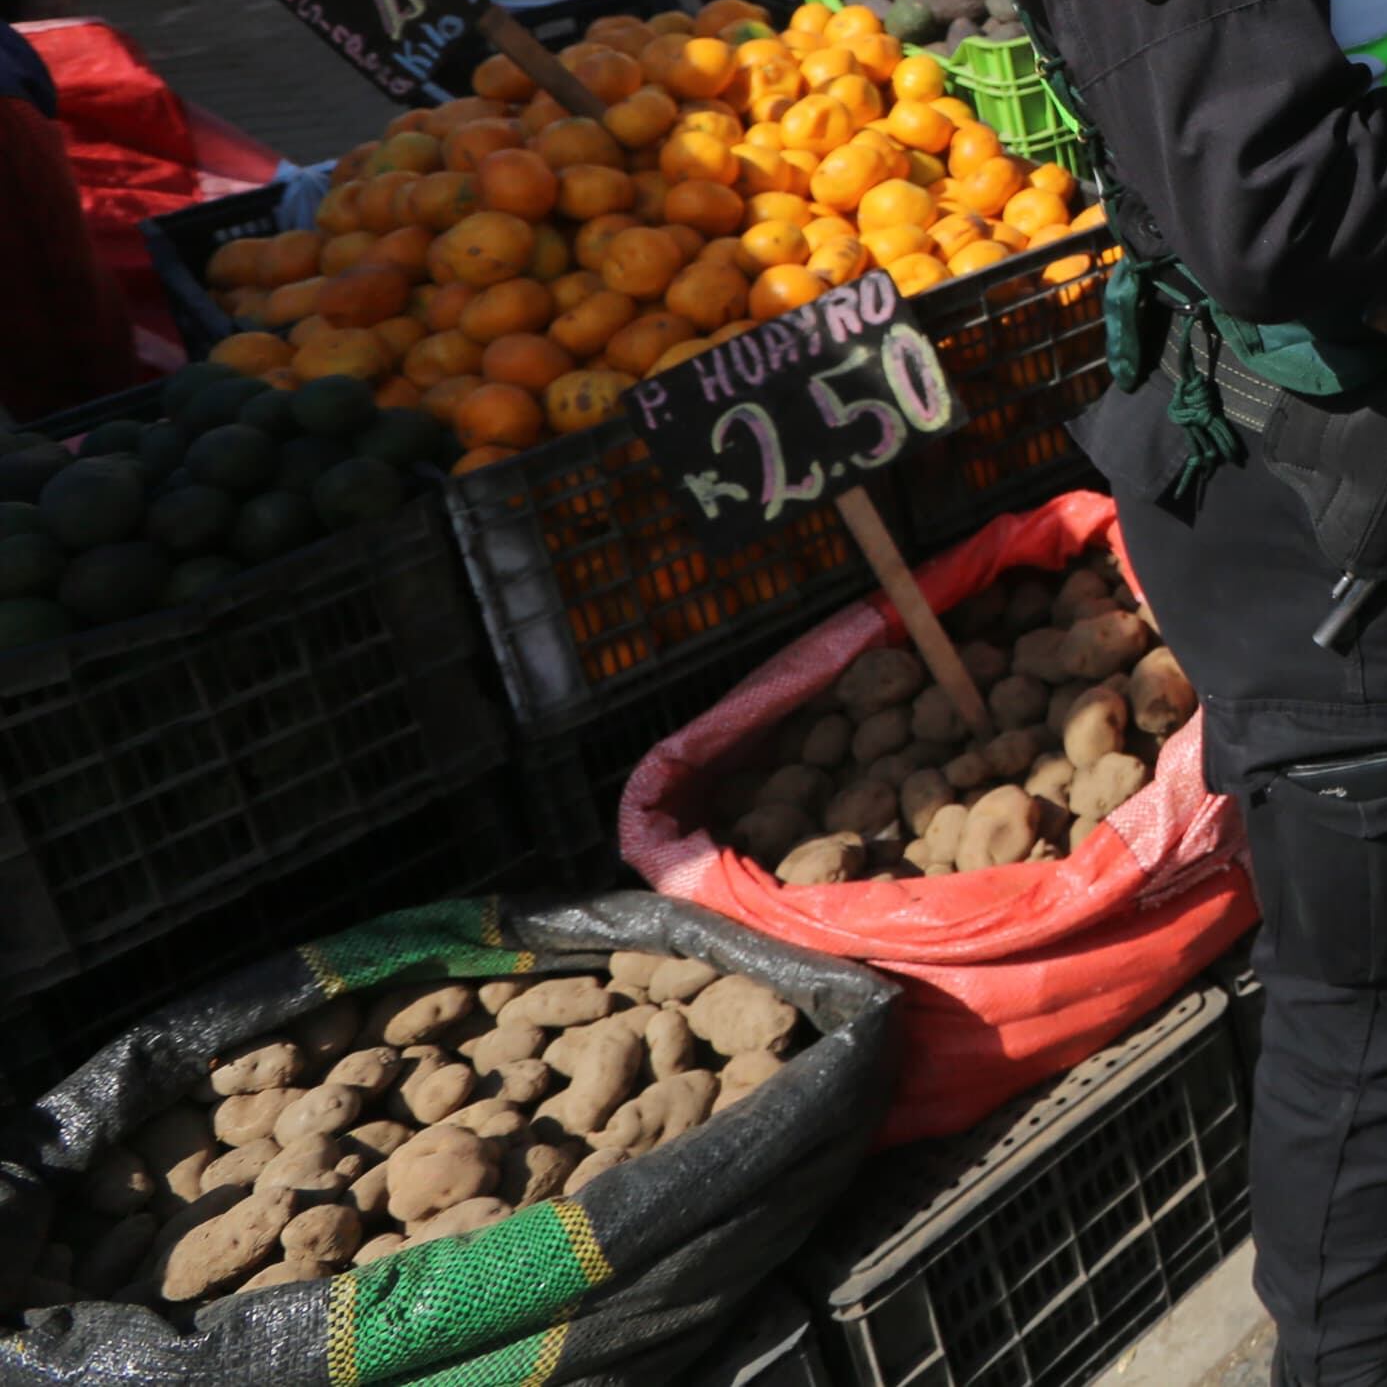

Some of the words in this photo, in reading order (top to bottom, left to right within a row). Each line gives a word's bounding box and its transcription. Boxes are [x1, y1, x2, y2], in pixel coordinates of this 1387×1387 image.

[635, 379, 674, 430] P.
[692, 269, 897, 402] HUAYRO
[711, 322, 952, 521] 2.50
